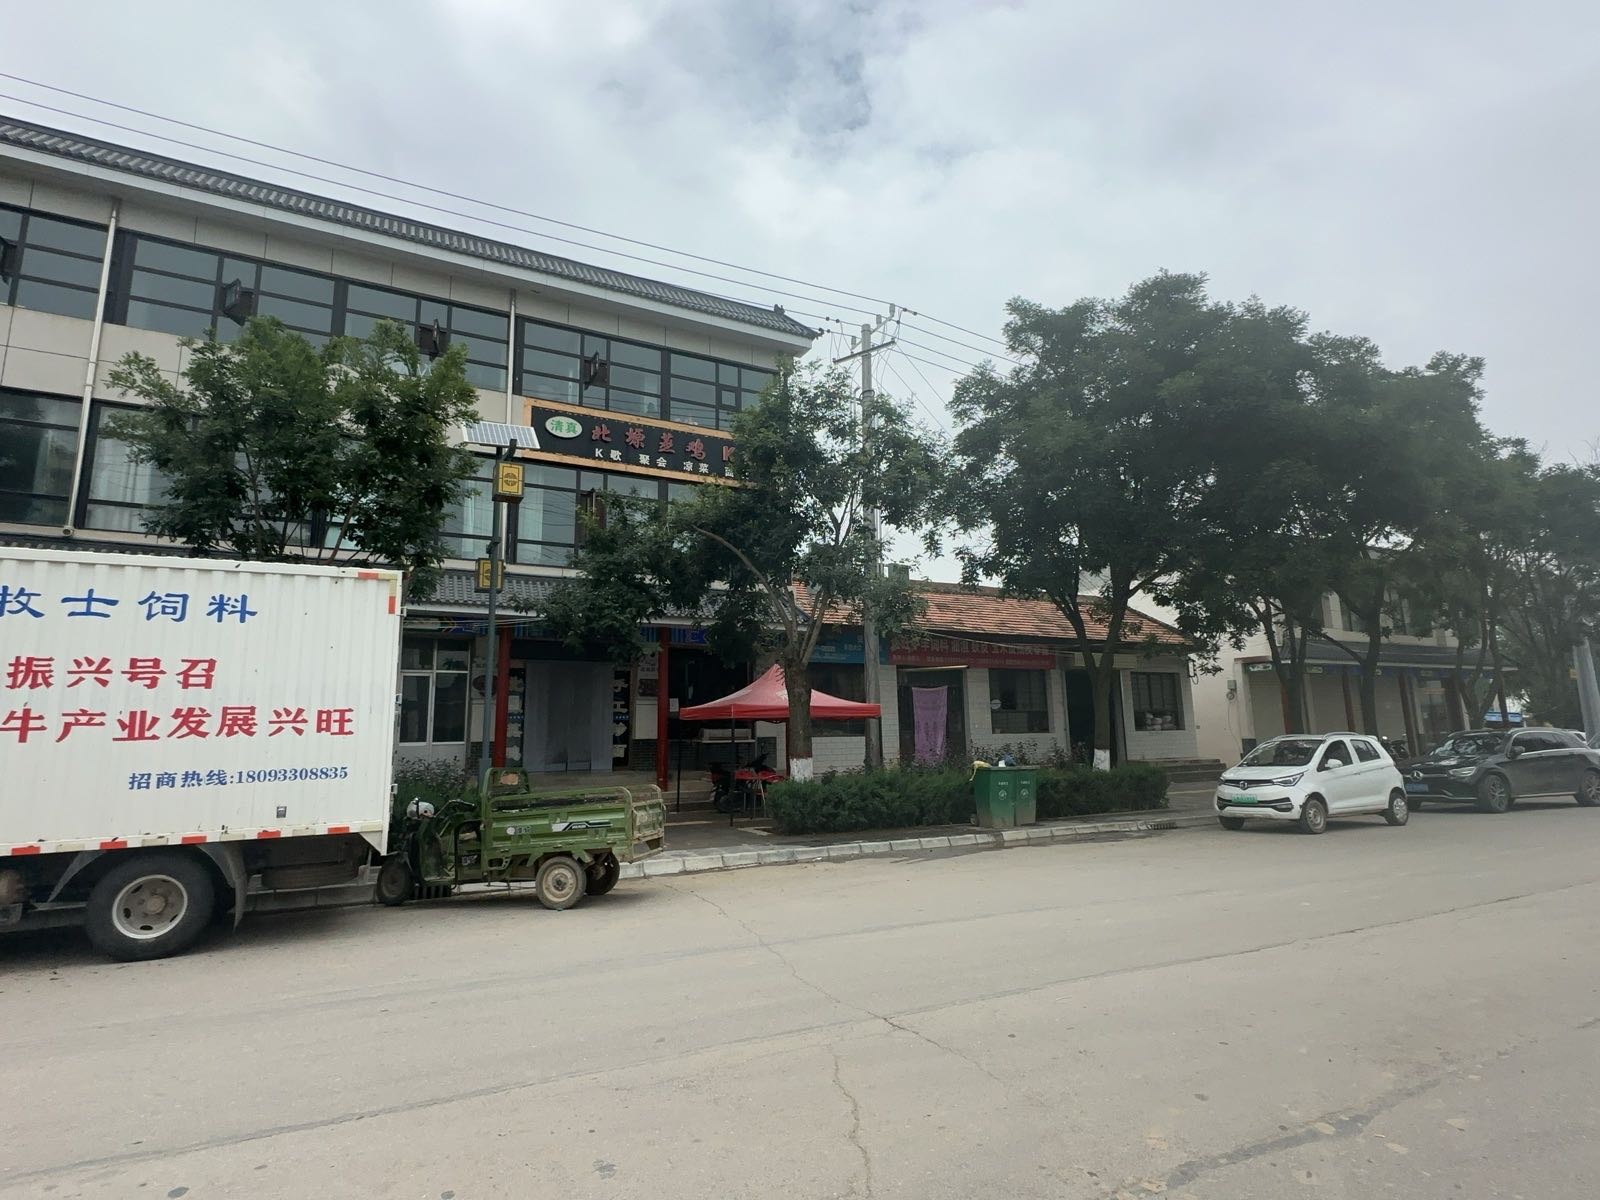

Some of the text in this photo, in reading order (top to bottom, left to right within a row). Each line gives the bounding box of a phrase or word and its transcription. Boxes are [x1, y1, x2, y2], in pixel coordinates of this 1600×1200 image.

[551, 418, 578, 435] 清真
[6, 655, 218, 690] 振兴号召
[0, 705, 355, 743] 牛产业发展兴旺
